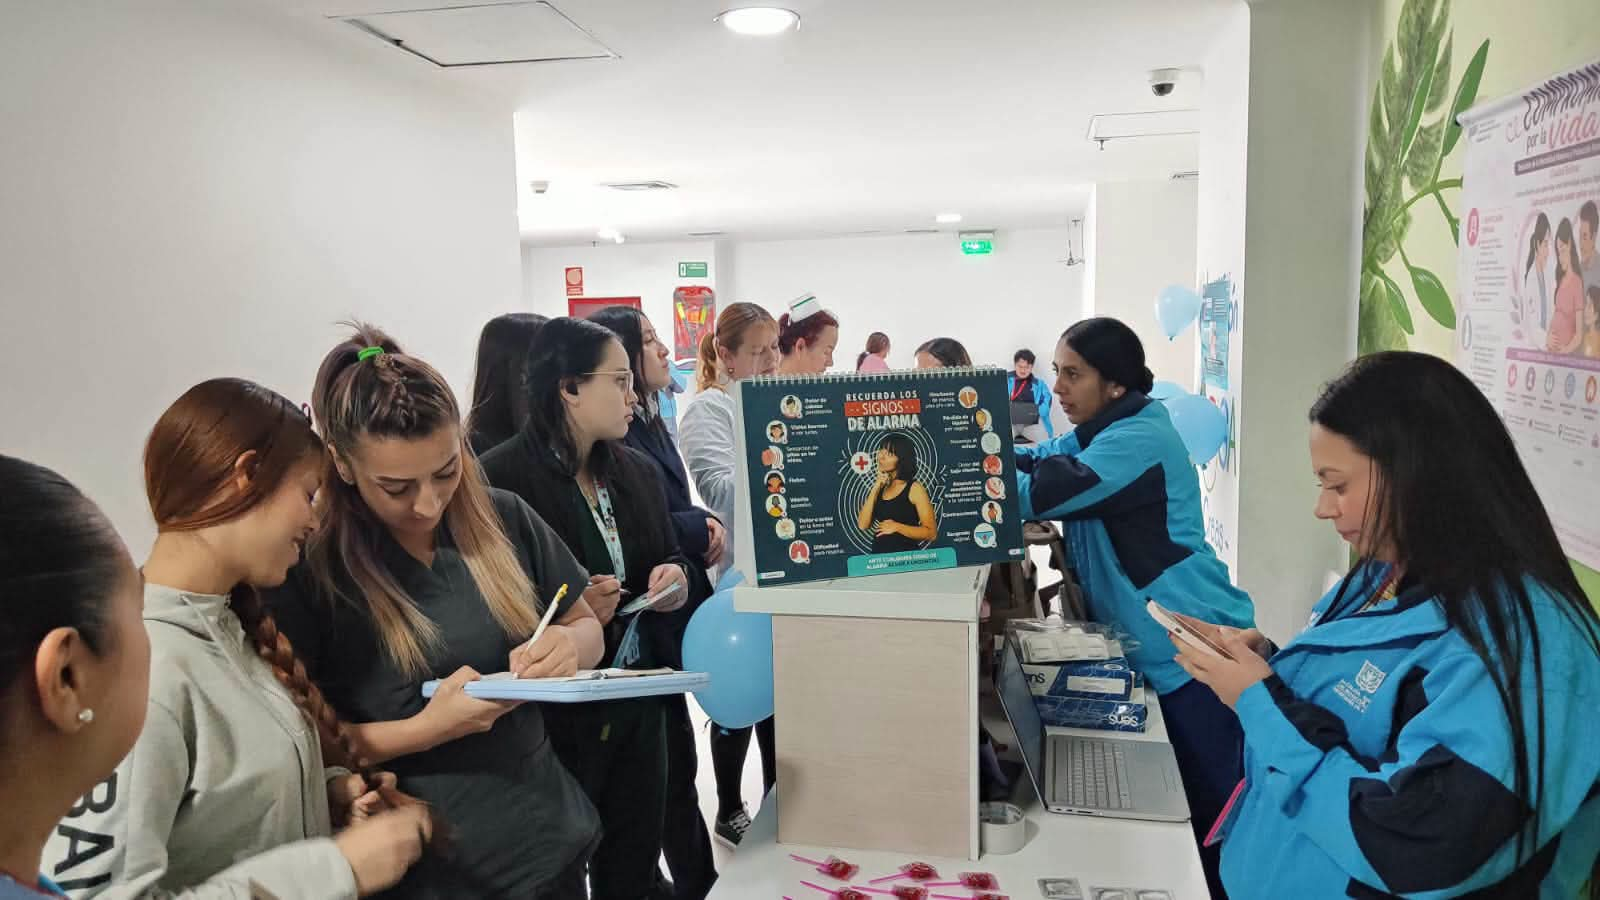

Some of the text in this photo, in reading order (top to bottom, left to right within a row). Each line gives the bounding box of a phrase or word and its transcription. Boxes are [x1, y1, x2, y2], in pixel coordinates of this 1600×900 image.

[1527, 133, 1539, 155] por
[845, 390, 918, 401] RECUERDA LOS
[862, 401, 904, 416] SIGNOS
[847, 413, 920, 432] DE ALARMA
